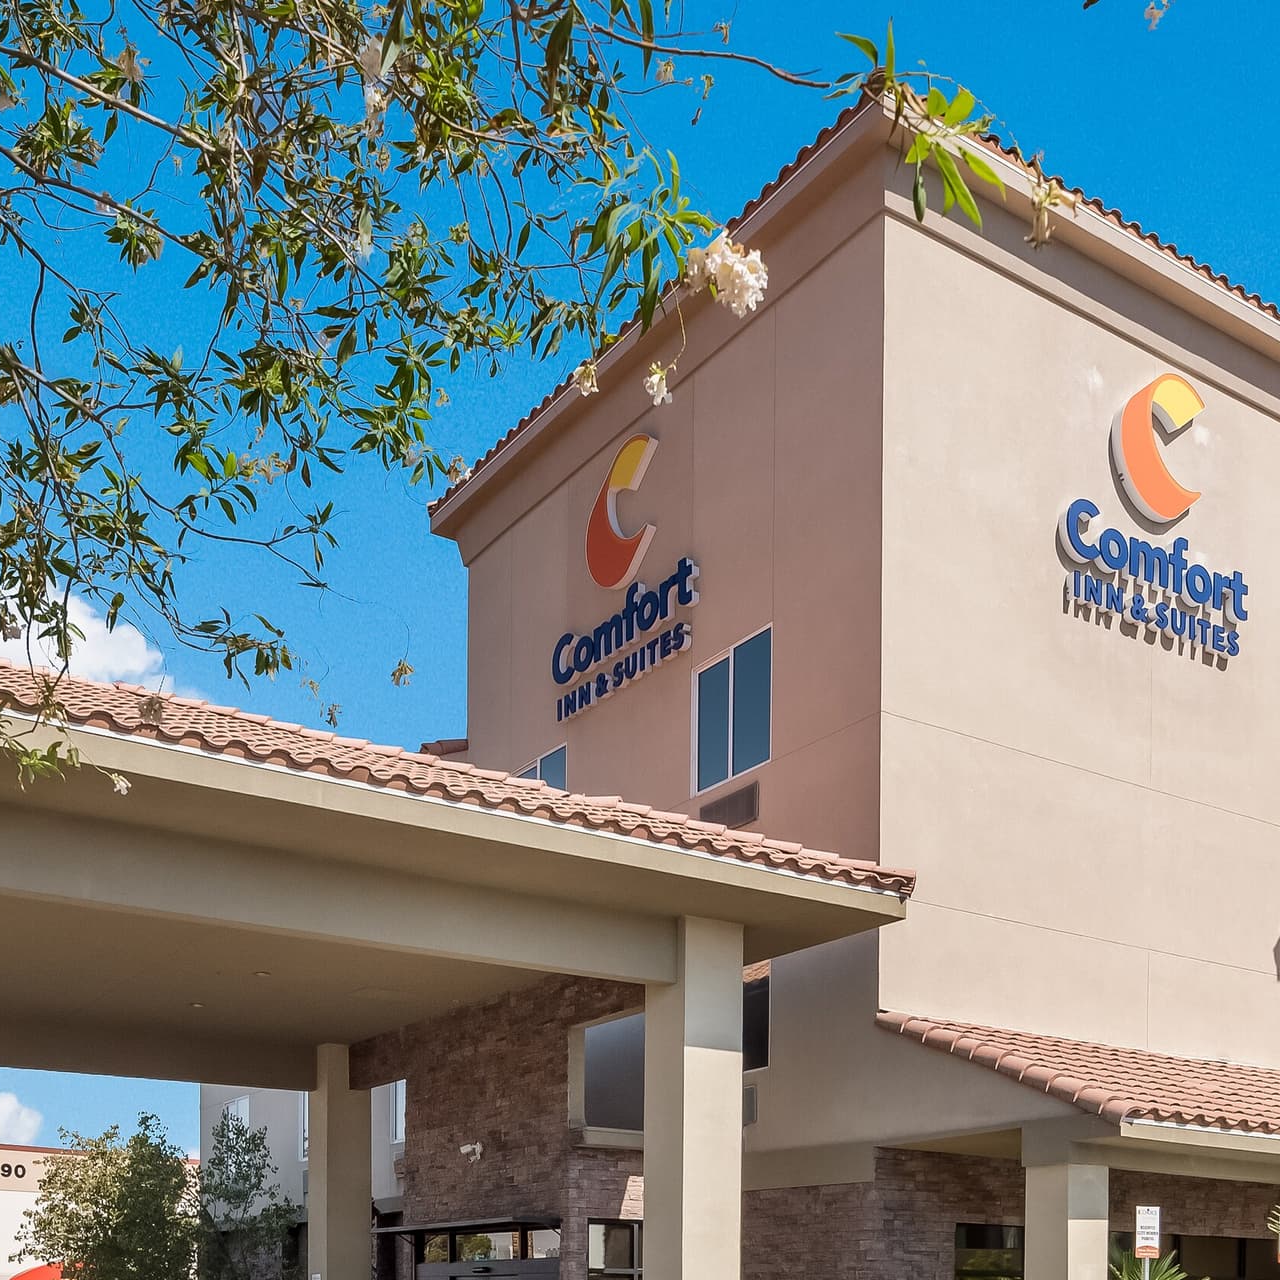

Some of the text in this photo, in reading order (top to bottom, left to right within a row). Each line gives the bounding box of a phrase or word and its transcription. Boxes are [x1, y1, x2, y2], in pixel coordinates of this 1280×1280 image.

[1065, 498, 1249, 621] Comfort
[1073, 570, 1240, 657] INN & SUITES
[551, 557, 696, 685] Comfort
[556, 622, 688, 722] INN & SUITES
